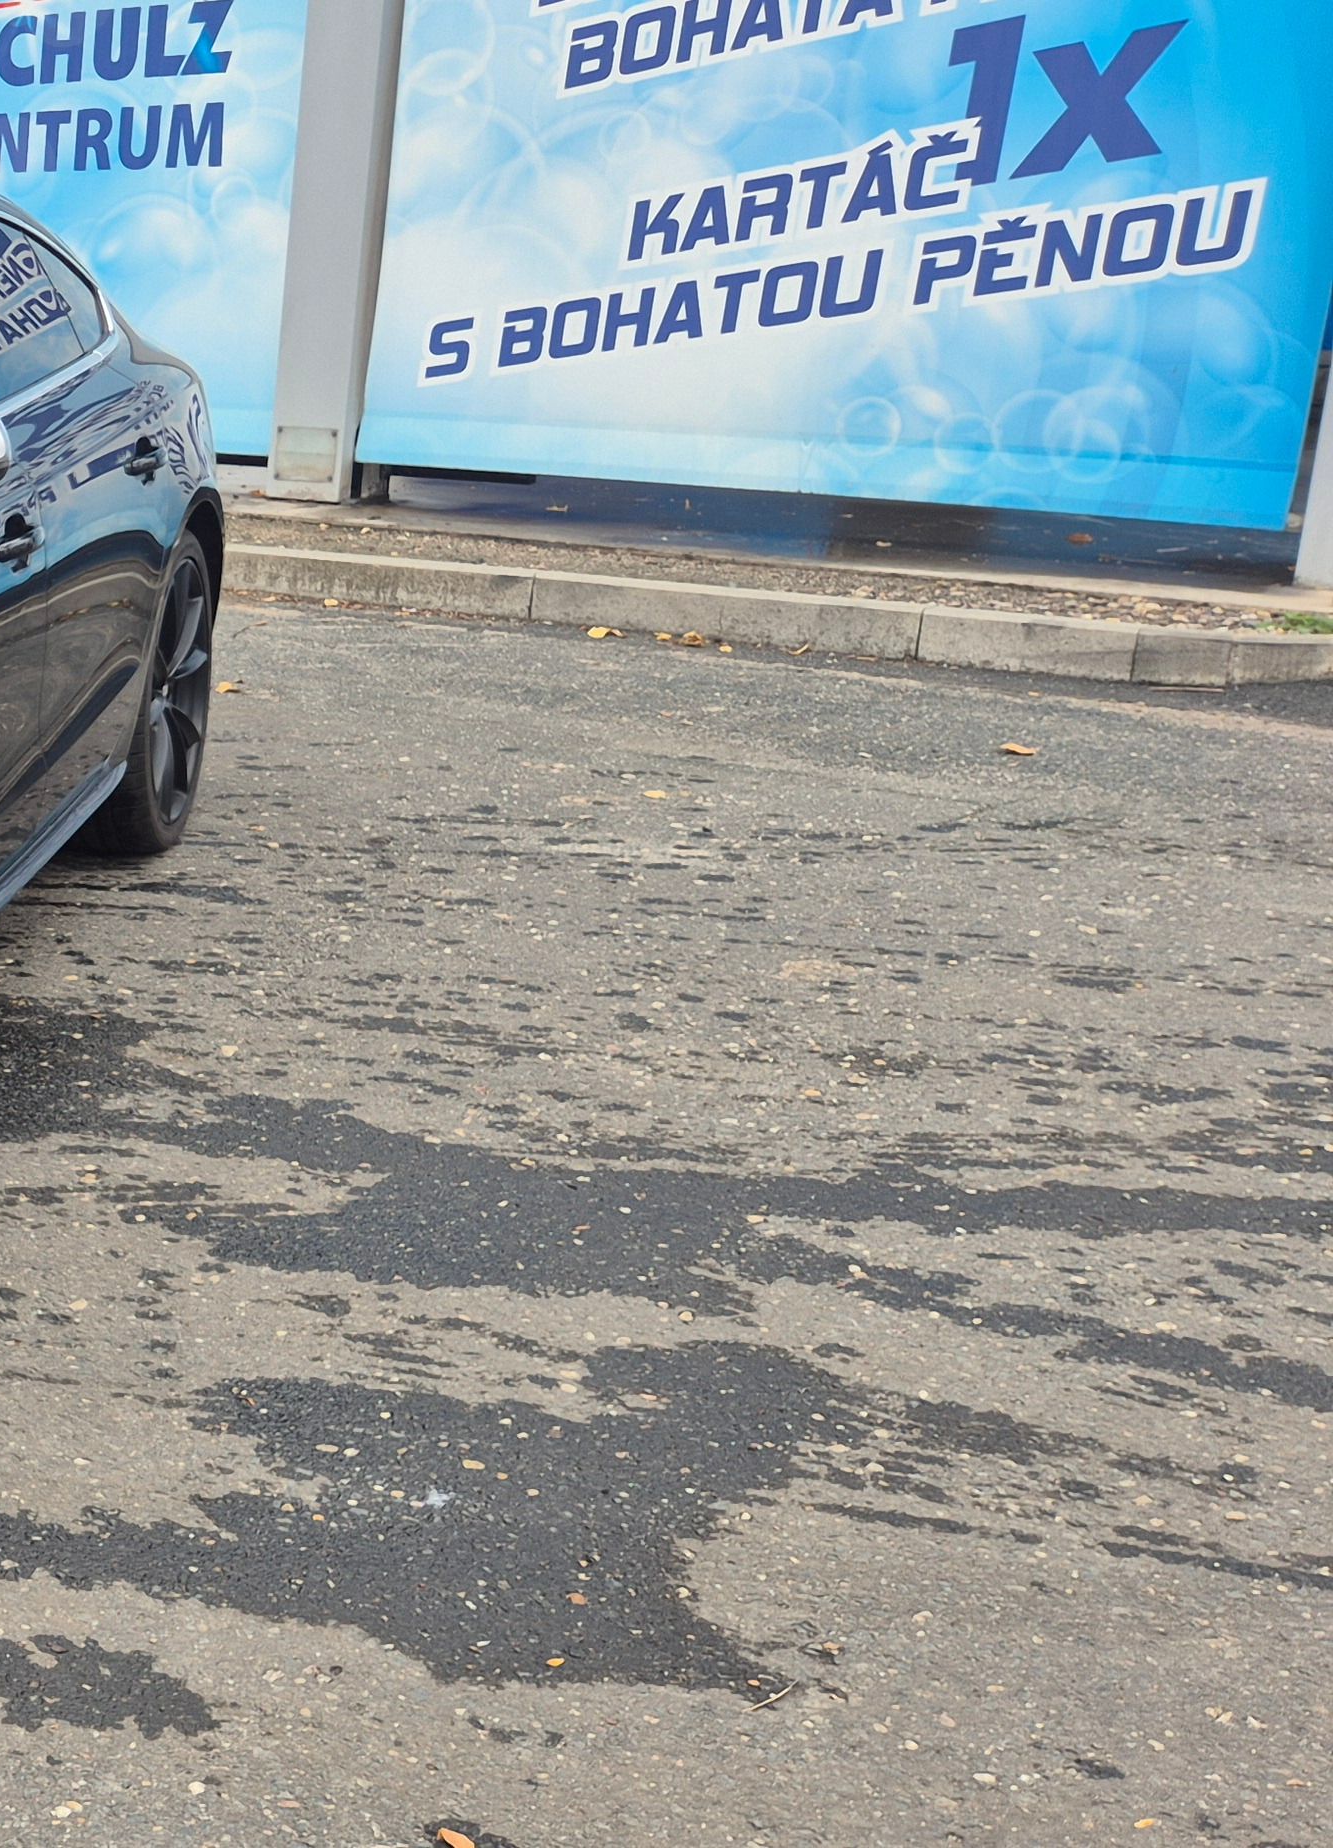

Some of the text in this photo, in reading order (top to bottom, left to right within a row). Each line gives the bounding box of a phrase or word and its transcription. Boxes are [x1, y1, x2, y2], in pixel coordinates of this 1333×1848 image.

[628, 131, 981, 261] KARTÁČ
[425, 189, 1254, 379] S BOHATOU PĚNOU
